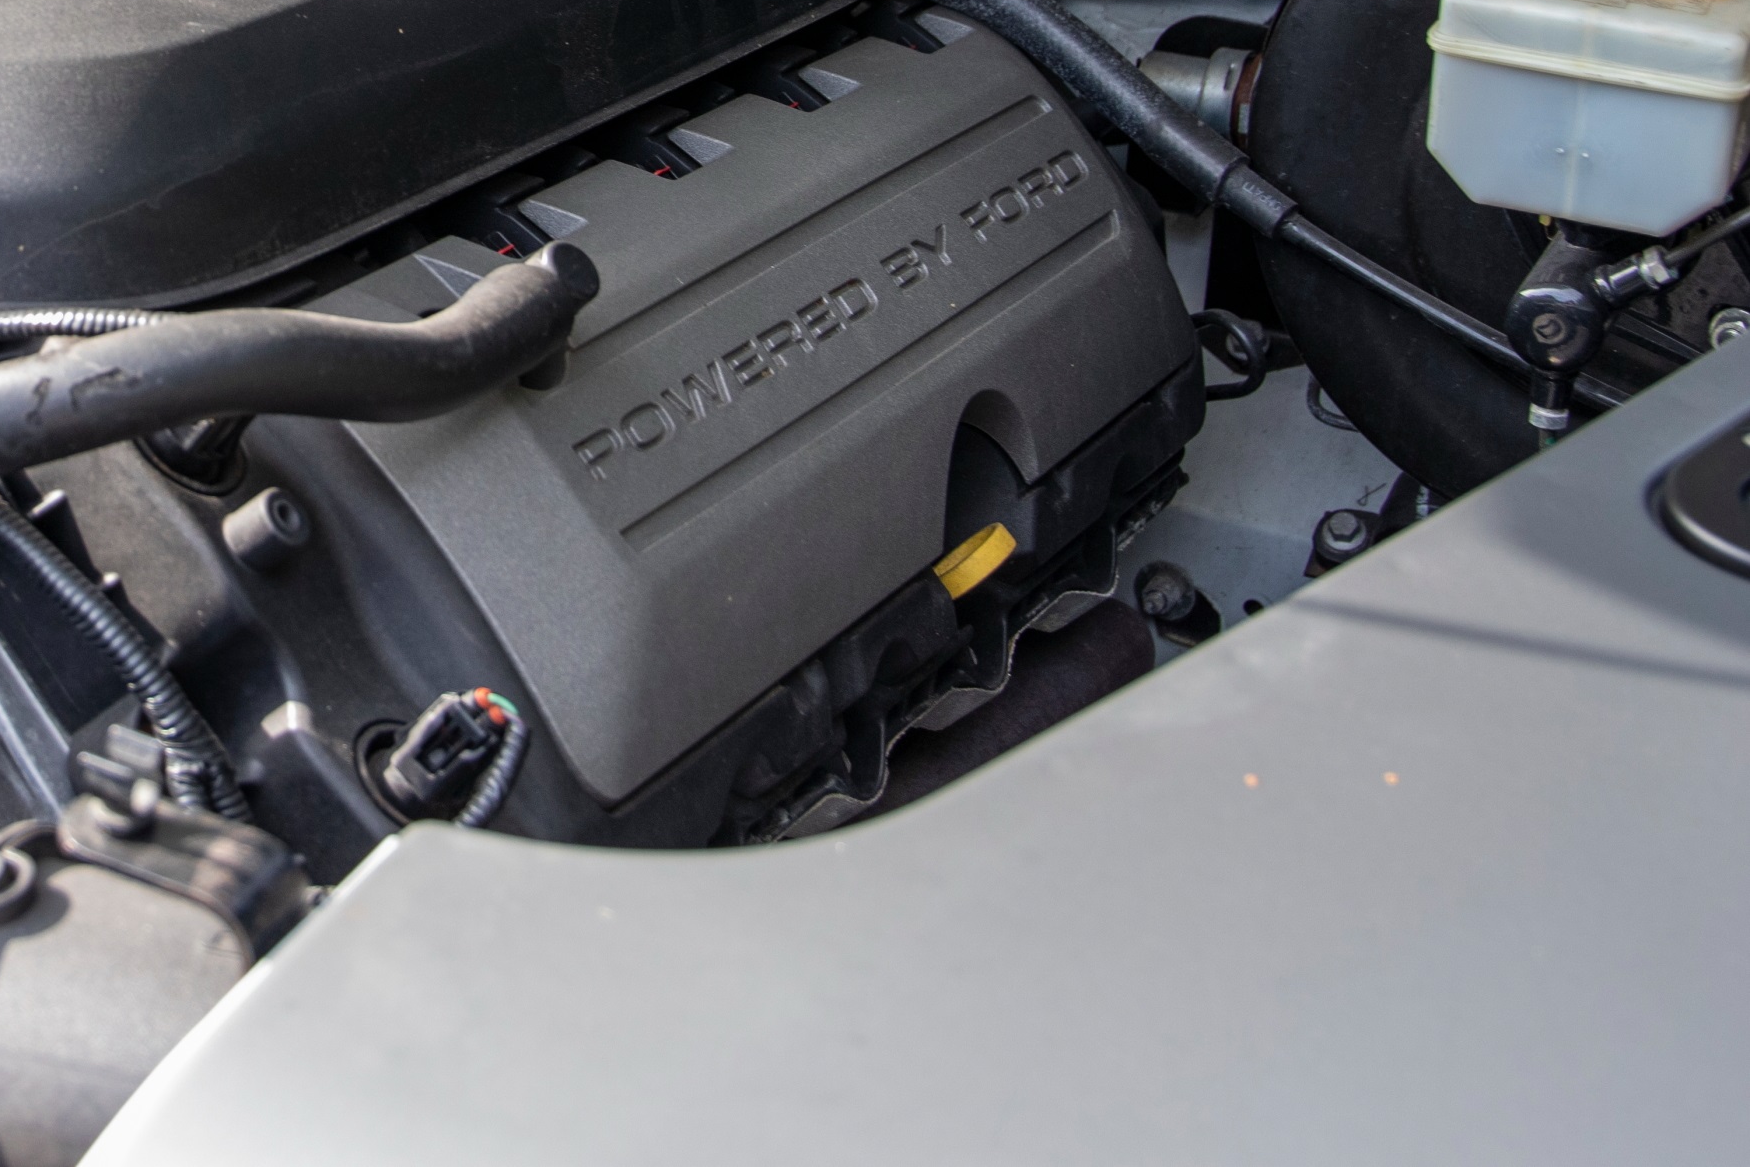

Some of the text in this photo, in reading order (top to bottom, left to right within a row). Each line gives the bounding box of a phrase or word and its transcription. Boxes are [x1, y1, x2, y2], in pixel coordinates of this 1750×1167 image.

[571, 149, 1089, 480] POWERED BY FORD
